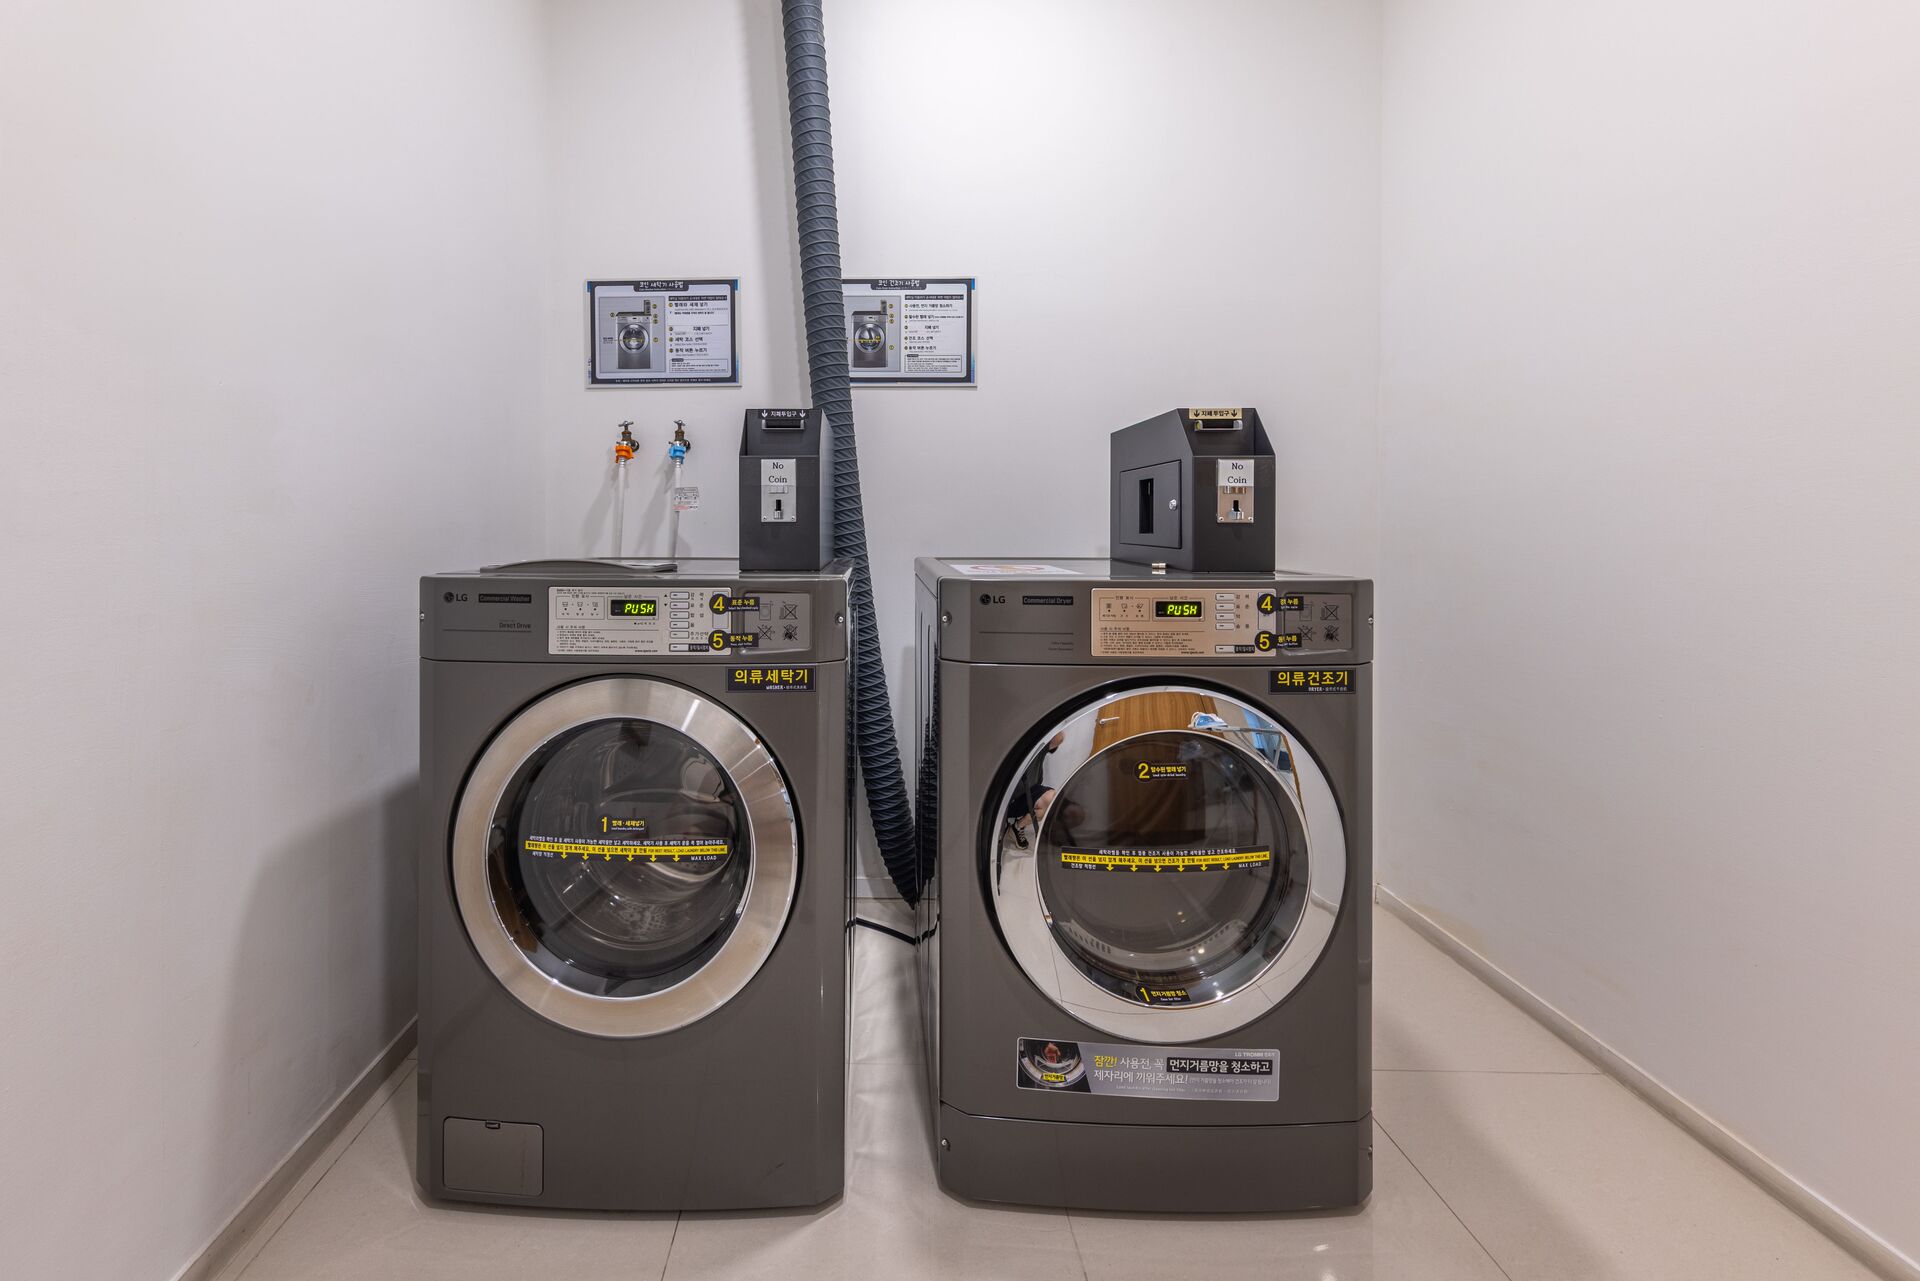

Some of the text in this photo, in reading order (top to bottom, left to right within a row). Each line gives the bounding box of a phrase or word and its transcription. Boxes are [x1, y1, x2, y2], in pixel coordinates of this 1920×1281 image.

[456, 594, 468, 602] LG
[713, 596, 725, 611] 4
[993, 596, 1006, 604] LG
[1261, 596, 1273, 611] 4
[624, 603, 654, 614] PUSH
[1167, 605, 1197, 615] PUSH
[713, 633, 723, 648] 5
[1259, 634, 1270, 649] 5
[734, 669, 808, 684] 의류세탁기
[1277, 671, 1347, 686] 의류건조기
[1138, 763, 1150, 778] 2
[601, 816, 607, 833] 1
[1140, 987, 1150, 1002] 1
[1094, 1055, 1270, 1073] 잠깐! 사용전, 꼭 먼지거름망을 청소하고
[1094, 1070, 1133, 1083] 제자리에
[1136, 1072, 1188, 1085] 끼워주세요!
